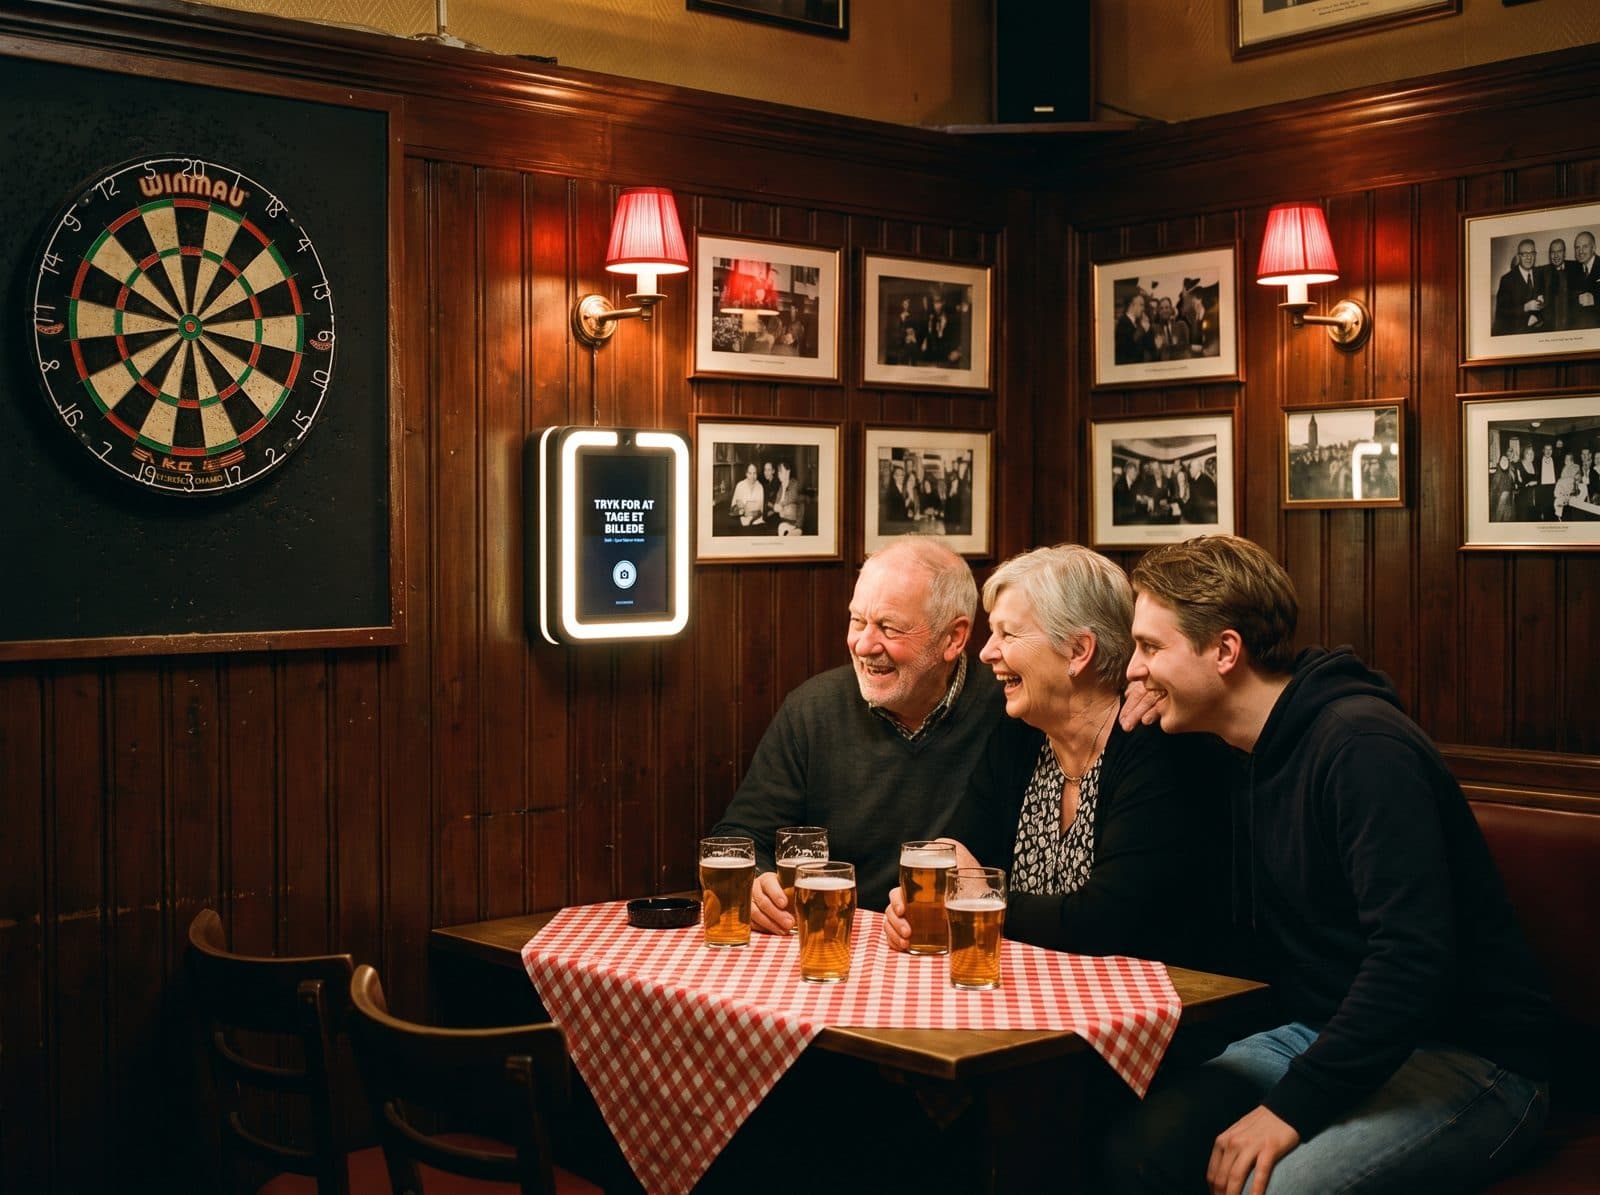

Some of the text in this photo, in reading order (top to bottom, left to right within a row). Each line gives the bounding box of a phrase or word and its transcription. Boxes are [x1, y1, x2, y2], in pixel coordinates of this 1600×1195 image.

[144, 160, 156, 180] 5
[182, 159, 205, 179] 20
[96, 177, 120, 201] 12
[138, 172, 245, 208] WINMAU
[265, 195, 288, 218] 18
[63, 214, 82, 232] 9
[298, 238, 312, 253] 4
[40, 252, 63, 275] 14
[311, 282, 332, 301] 13
[35, 305, 57, 323] 11
[40, 360, 59, 373] 8
[310, 370, 331, 393] 10
[57, 403, 84, 428] 16
[291, 410, 312, 434] 15
[97, 440, 112, 459] 7
[265, 449, 286, 465] 2
[135, 463, 157, 485] 19
[184, 474, 194, 492] 3
[225, 466, 241, 488] 17
[594, 499, 655, 510] TRYK FOR AT
[604, 512, 644, 522] TAGE ET
[604, 523, 645, 534] BILLEDE
